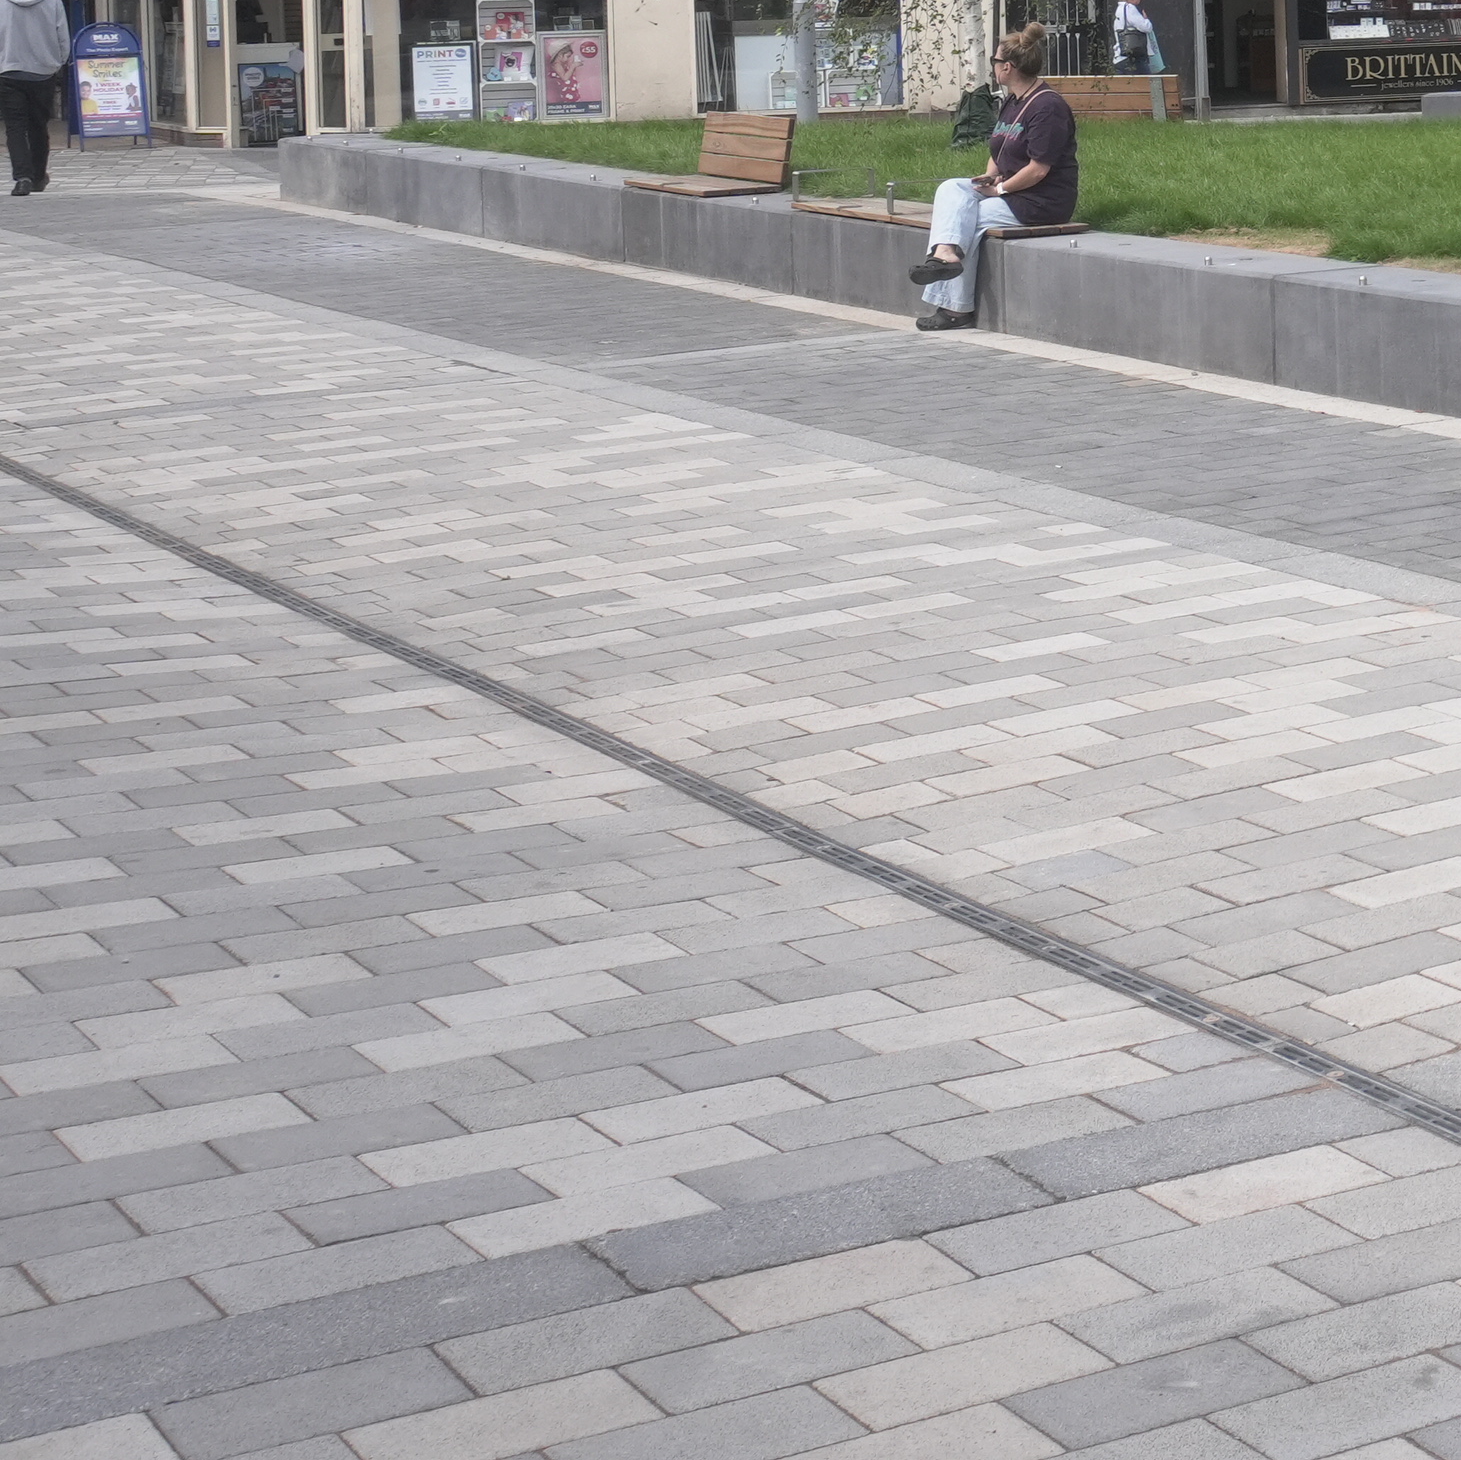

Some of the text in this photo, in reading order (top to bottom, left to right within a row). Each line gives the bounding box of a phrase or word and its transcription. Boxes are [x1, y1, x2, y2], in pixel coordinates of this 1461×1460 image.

[92, 33, 119, 41] MAX
[416, 49, 454, 59] PRINT
[87, 60, 126, 70] Summer
[92, 69, 123, 79] Smiles
[1381, 78, 1454, 91] jewellers since 1906
